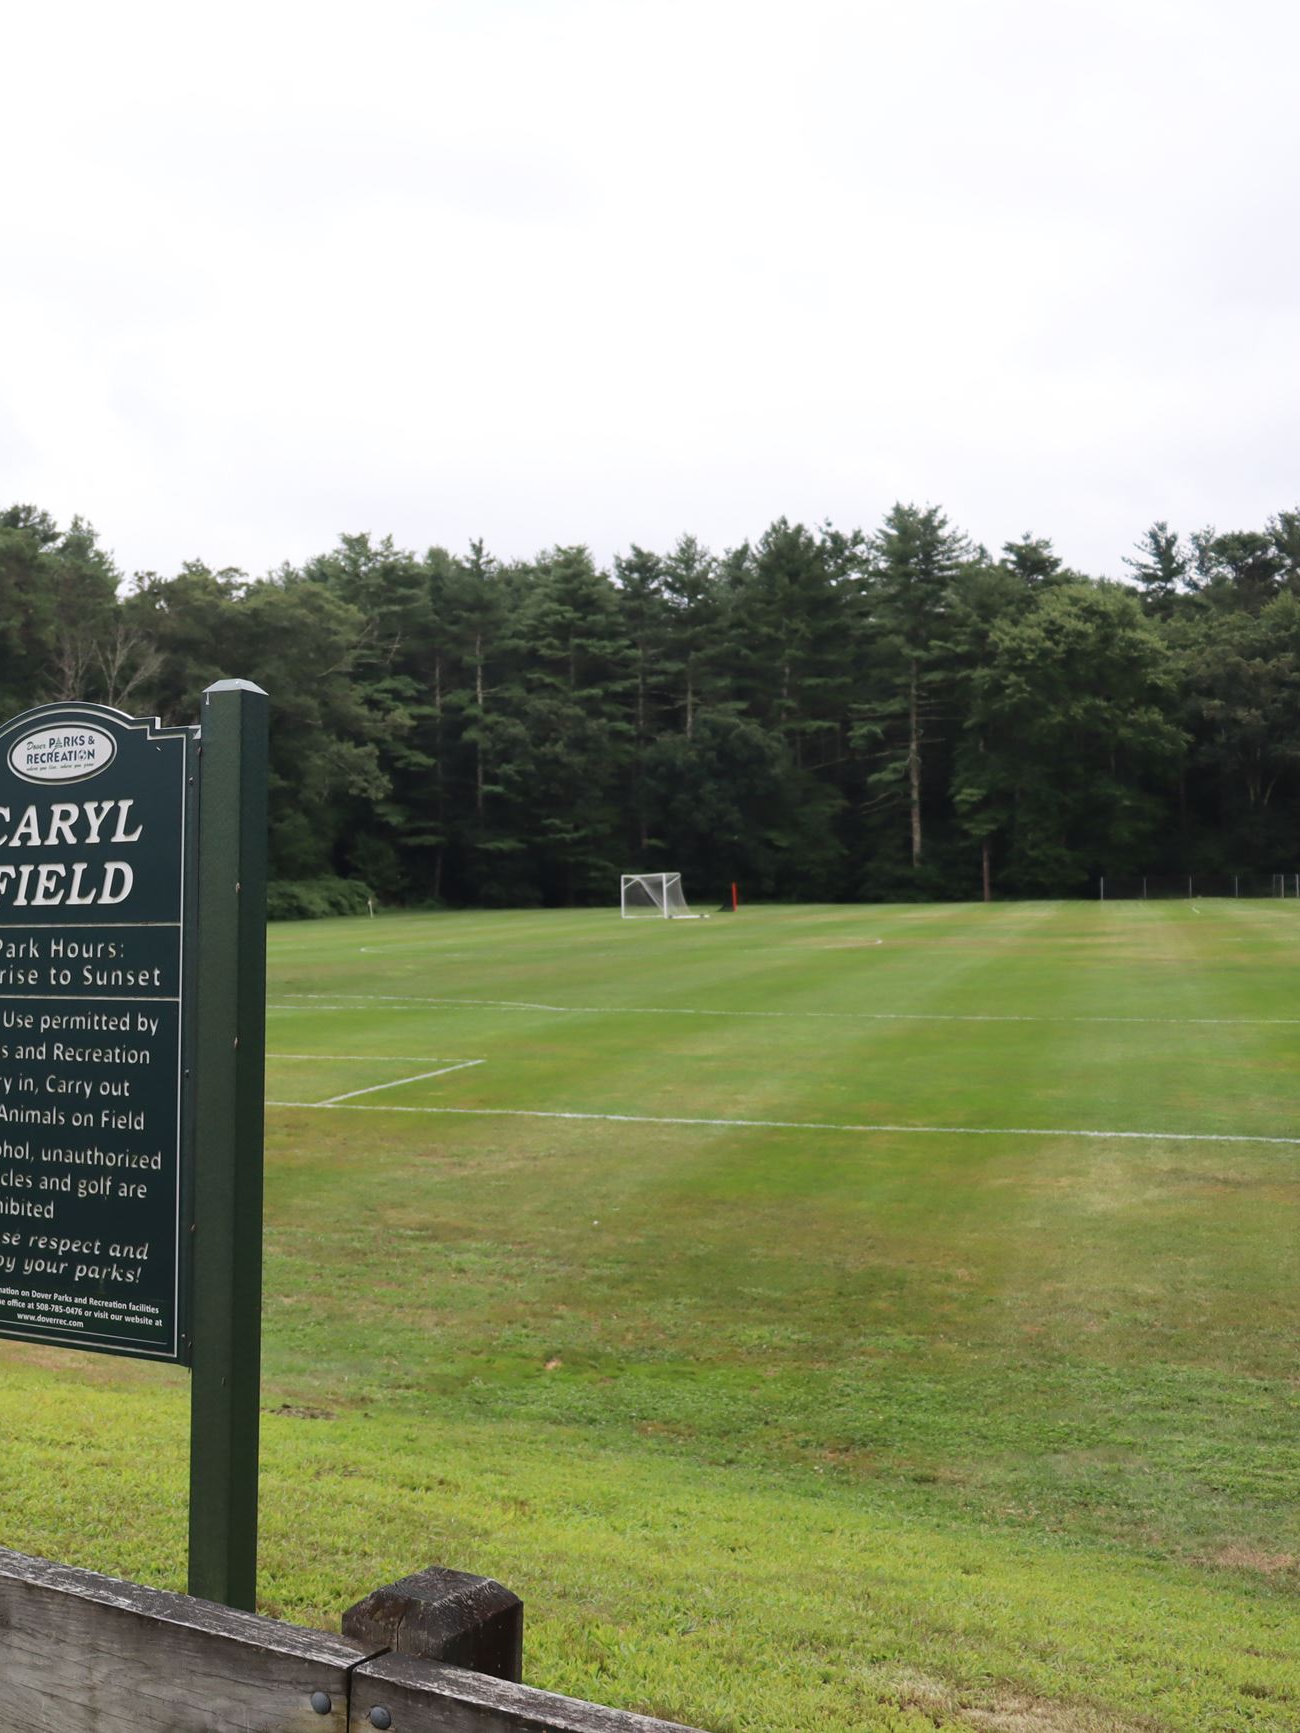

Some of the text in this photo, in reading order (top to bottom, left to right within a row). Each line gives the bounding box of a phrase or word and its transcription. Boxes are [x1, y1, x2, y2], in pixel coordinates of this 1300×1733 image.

[27, 735, 95, 750] Dover PARKS &
[27, 749, 95, 764] RECREATION
[50, 939, 124, 958] Hours:
[50, 967, 71, 985] to
[83, 965, 161, 986] Sunset
[3, 1011, 34, 1029] Use
[40, 1011, 130, 1033] permitted
[137, 1013, 158, 1036] by
[15, 1042, 46, 1060] and
[53, 1043, 150, 1064] Recreation
[18, 1073, 39, 1094] in,
[46, 1075, 93, 1099] Carry
[99, 1079, 130, 1097] out
[71, 1111, 94, 1127] on
[101, 1110, 144, 1130] Field
[41, 1147, 162, 1170] unauthorized
[39, 1173, 71, 1191] and
[78, 1176, 112, 1198] golf
[118, 1182, 148, 1198] are
[29, 1234, 101, 1255] respect
[109, 1243, 149, 1260] and
[23, 1256, 68, 1274] your
[74, 1264, 142, 1283] parks!
[7, 1299, 25, 1308] office
[36, 1303, 83, 1316] 508-785-0476
[94, 1311, 108, 1319] visit
[125, 1315, 153, 1325] website
[31, 1290, 52, 1299] Dover
[53, 1293, 72, 1302] Parks
[89, 1297, 127, 1309] Recreation
[129, 1302, 159, 1314] facilities
[17, 1313, 84, 1327] www.doverrec.com
